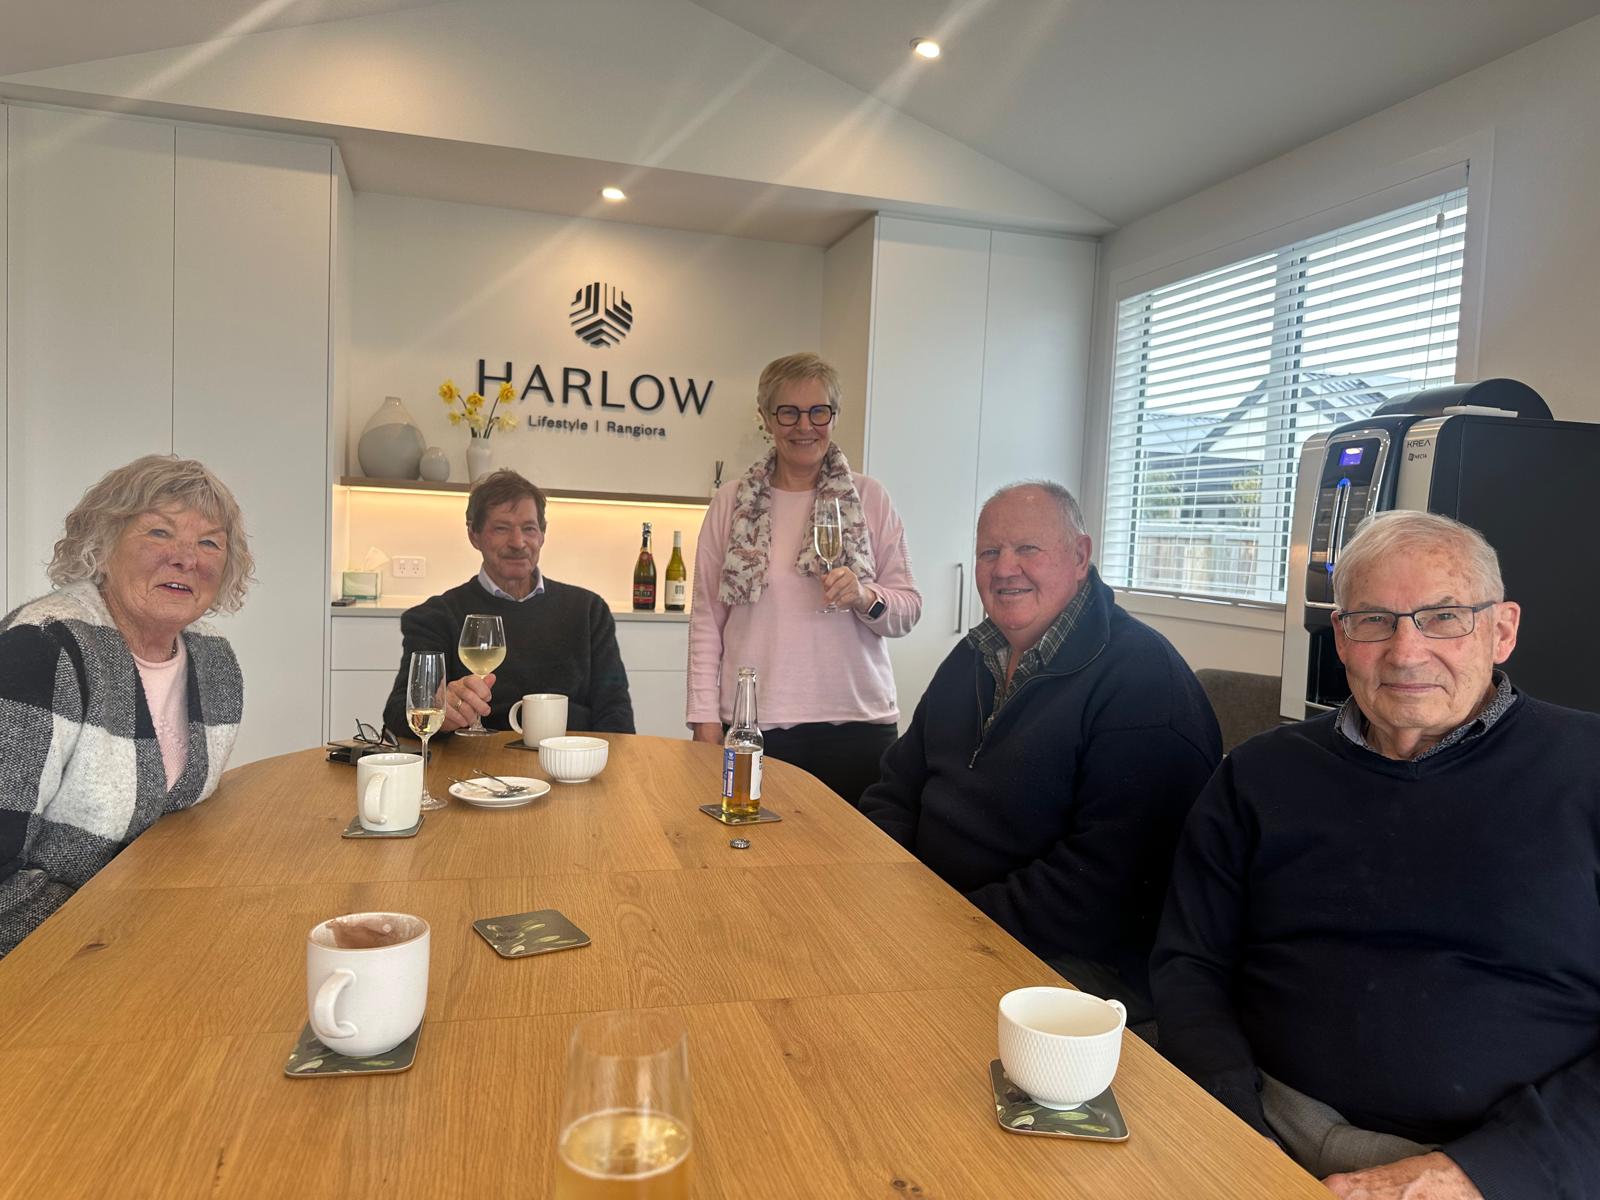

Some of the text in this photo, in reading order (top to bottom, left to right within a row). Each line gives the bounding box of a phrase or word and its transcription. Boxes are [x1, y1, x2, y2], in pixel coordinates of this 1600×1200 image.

[478, 359, 714, 415] HARLOW
[528, 415, 588, 432] Lifestyle
[607, 421, 666, 438] Rangiora
